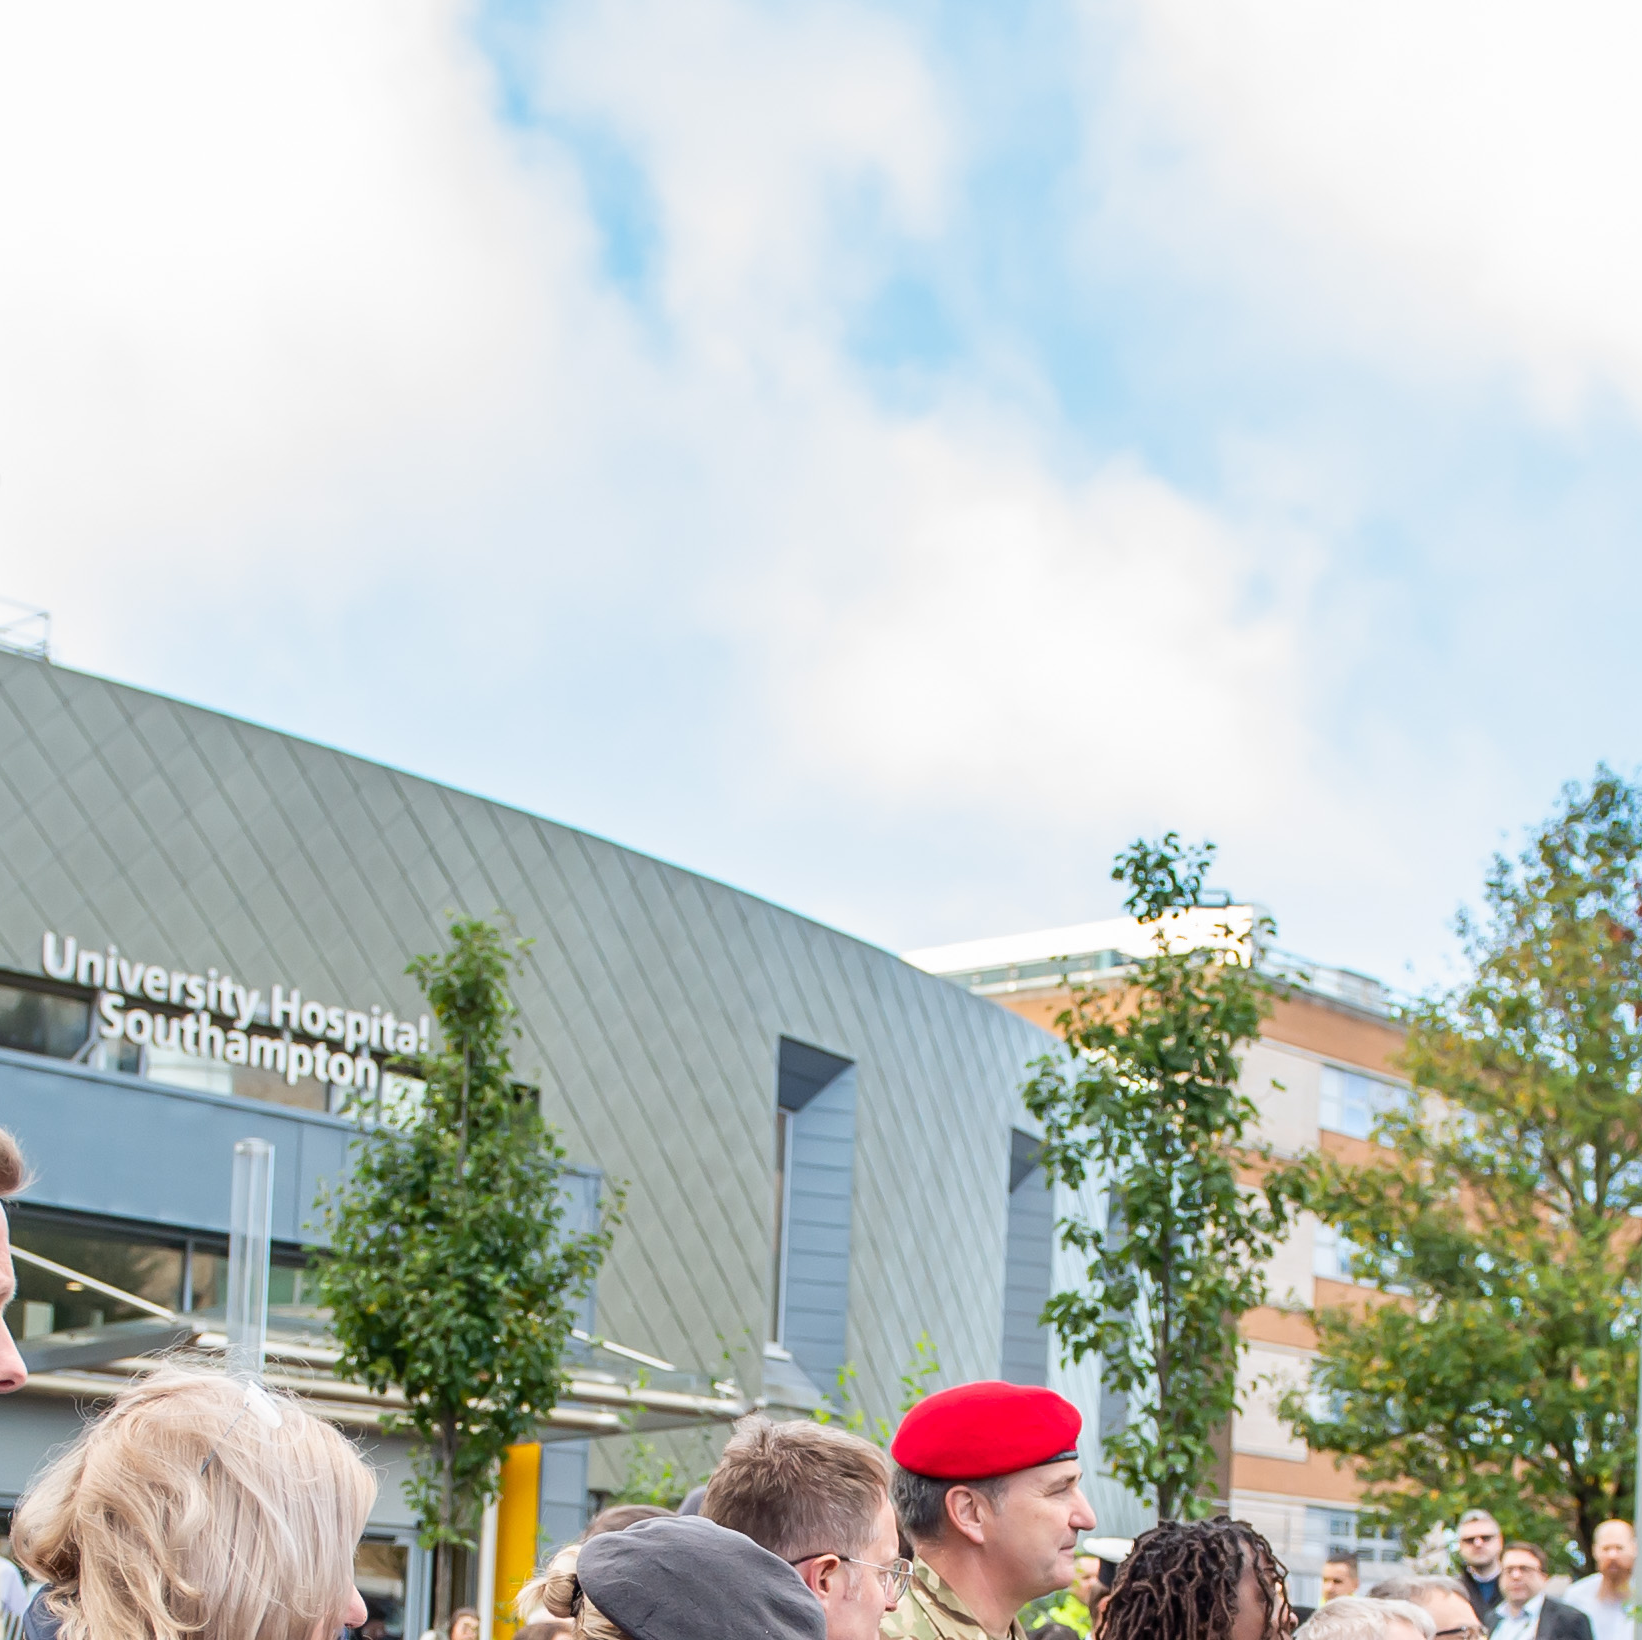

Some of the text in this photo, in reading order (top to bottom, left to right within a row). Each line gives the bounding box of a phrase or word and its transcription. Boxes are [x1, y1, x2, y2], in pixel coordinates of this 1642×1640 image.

[43, 929, 430, 1056] University Hospital
[98, 991, 380, 1089] Southampton
